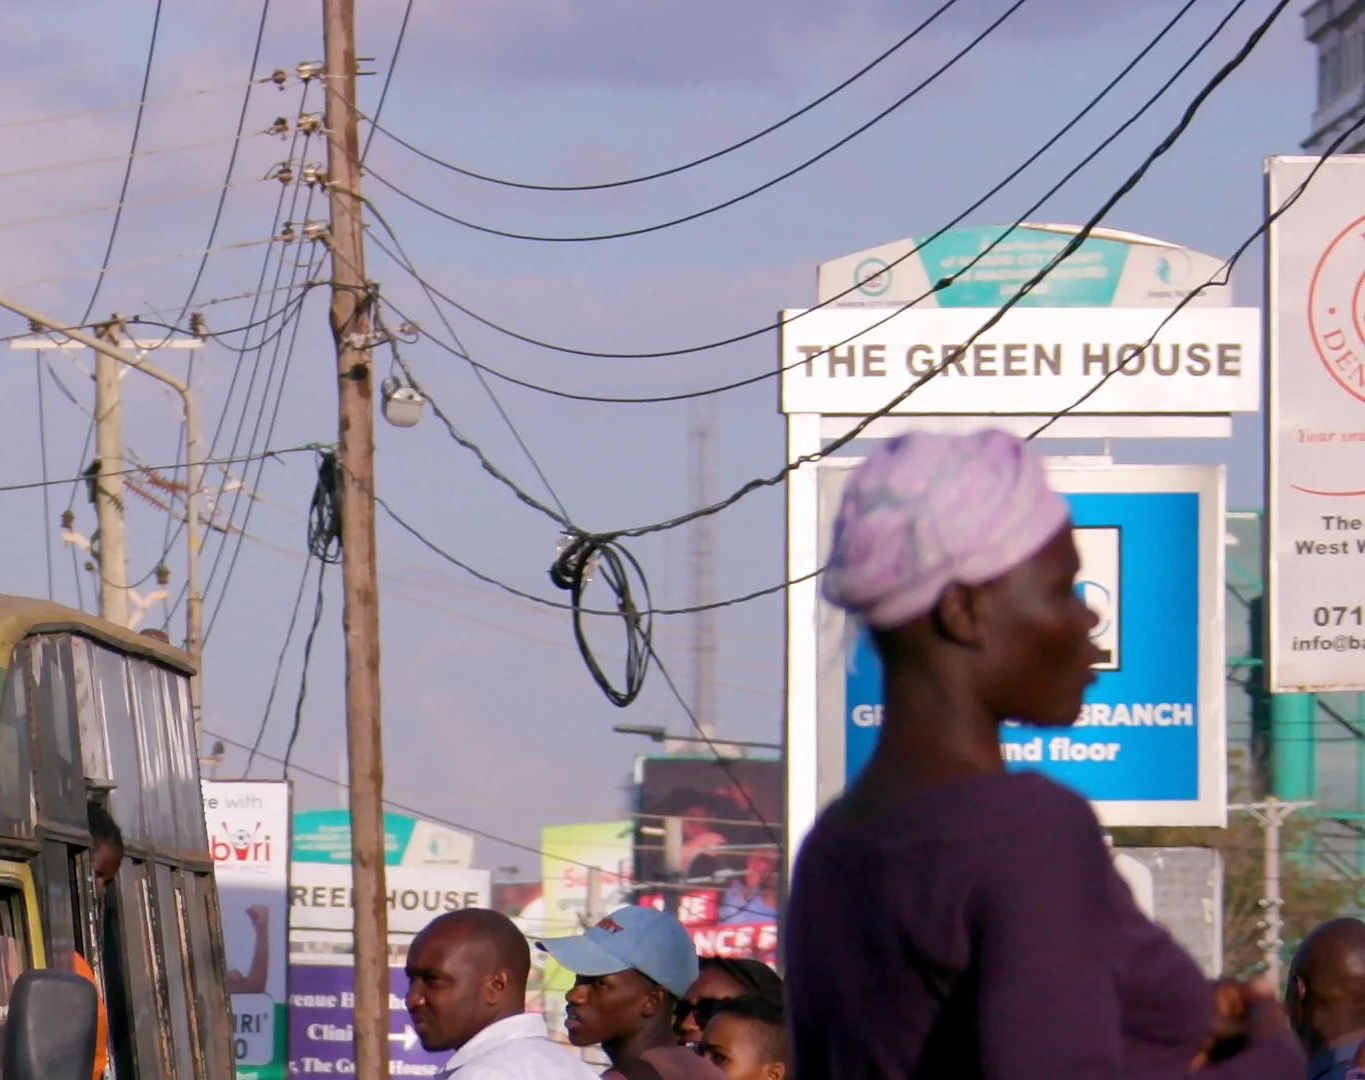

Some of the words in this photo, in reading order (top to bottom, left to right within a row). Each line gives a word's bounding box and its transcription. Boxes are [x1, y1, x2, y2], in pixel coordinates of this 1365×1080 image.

[796, 343, 887, 380] THE
[905, 343, 1063, 378] GREEN
[1081, 341, 1242, 378] HOUSE
[1322, 515, 1362, 531] The
[1295, 540, 1349, 556] West
[1049, 737, 1119, 762] floor
[307, 1023, 354, 1042] Clini
